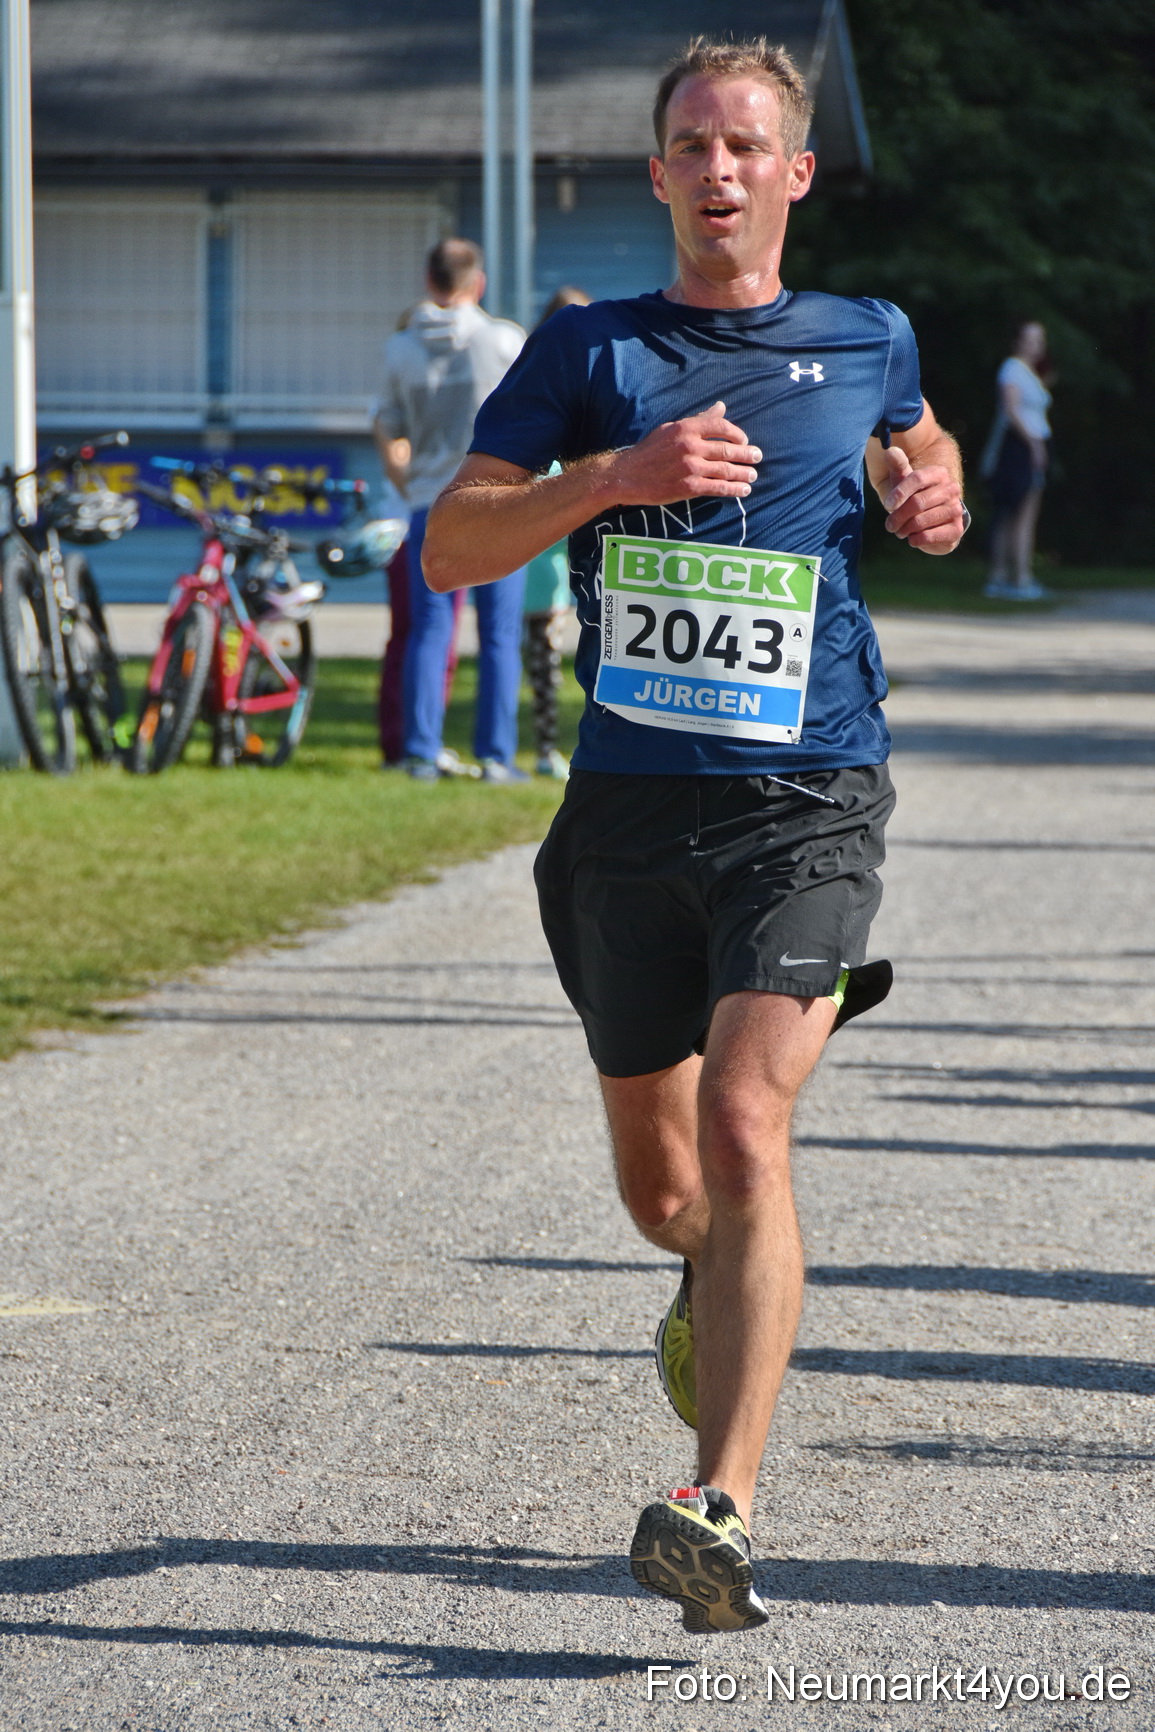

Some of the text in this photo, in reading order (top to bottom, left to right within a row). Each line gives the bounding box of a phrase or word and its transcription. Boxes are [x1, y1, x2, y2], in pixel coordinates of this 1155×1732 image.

[619, 545, 798, 603] BOCK
[625, 604, 784, 674] 2043
[793, 627, 802, 638] A
[633, 677, 761, 716] JÜRGEN
